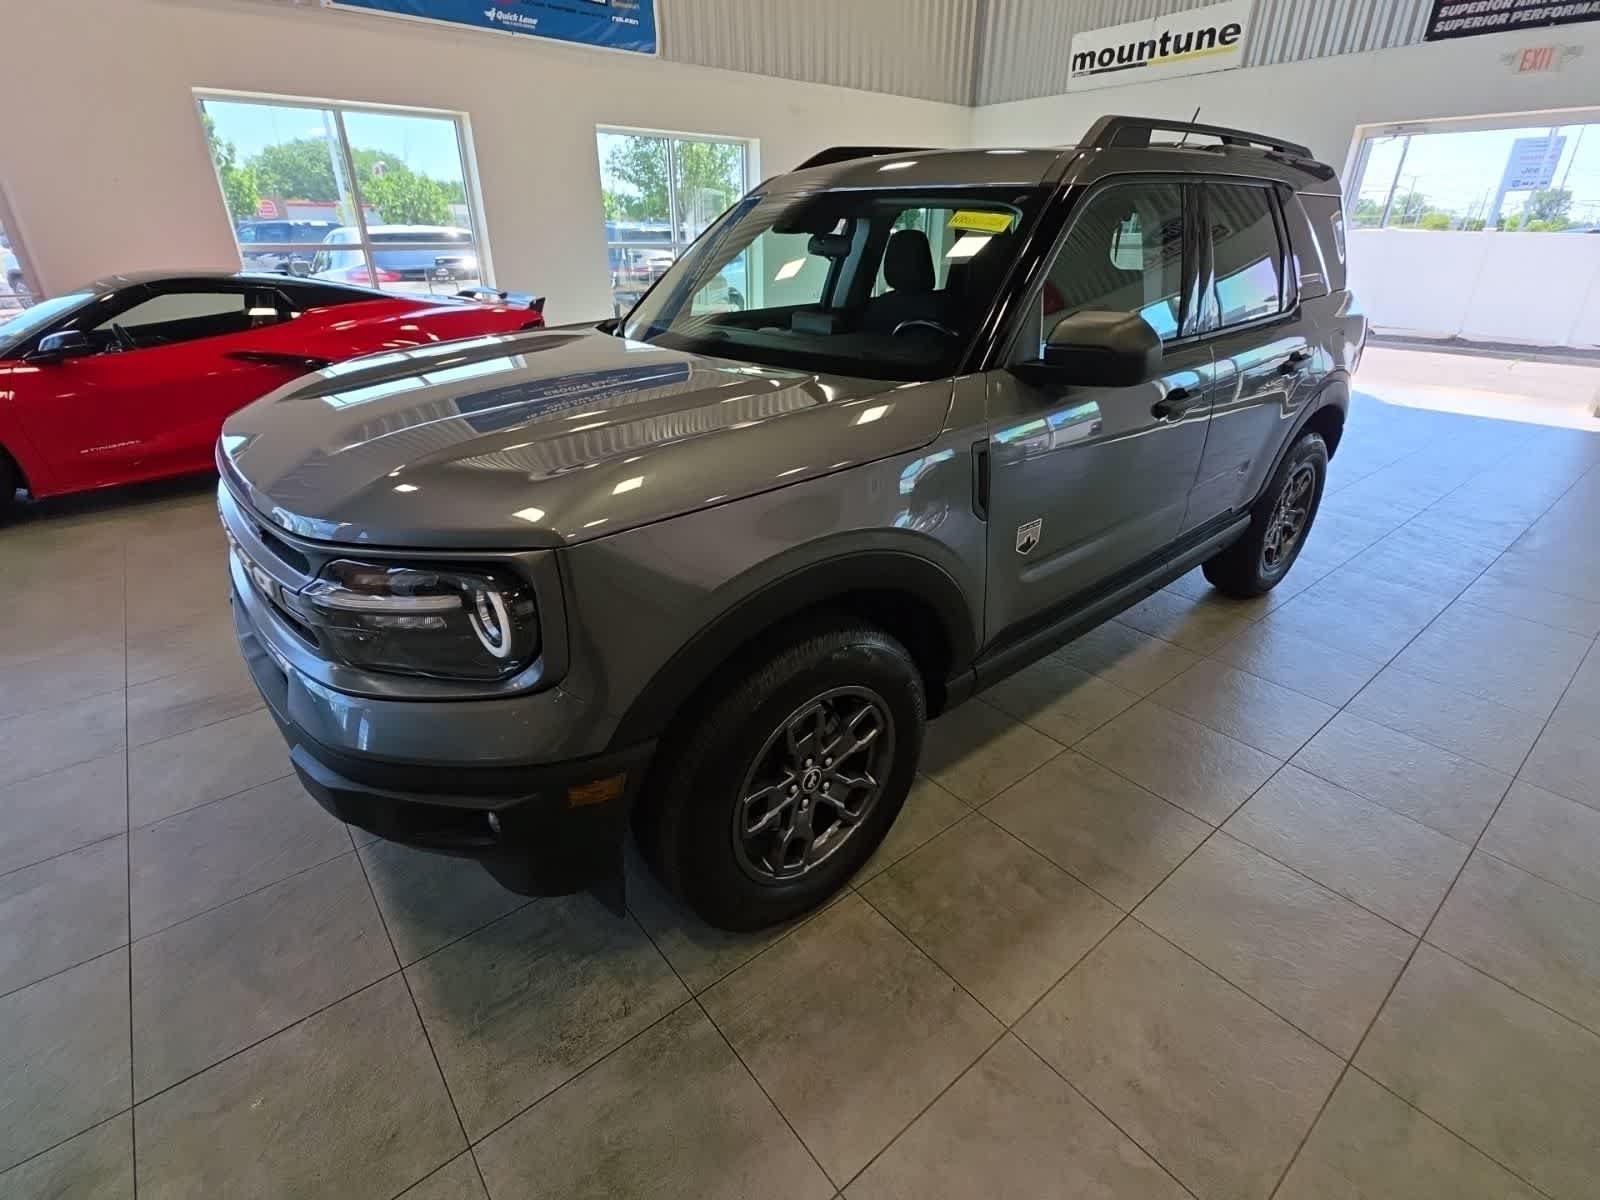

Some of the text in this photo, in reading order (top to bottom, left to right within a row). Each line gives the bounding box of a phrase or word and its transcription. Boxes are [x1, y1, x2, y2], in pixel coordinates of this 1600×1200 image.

[496, 10, 518, 22] Quick
[518, 14, 538, 25] Lane
[1433, 1, 1600, 33] SUPERIOR PERFORMA
[1438, 0, 1514, 18] SUPERIOR
[1072, 23, 1242, 72] mountune
[1518, 47, 1554, 72] EXIT
